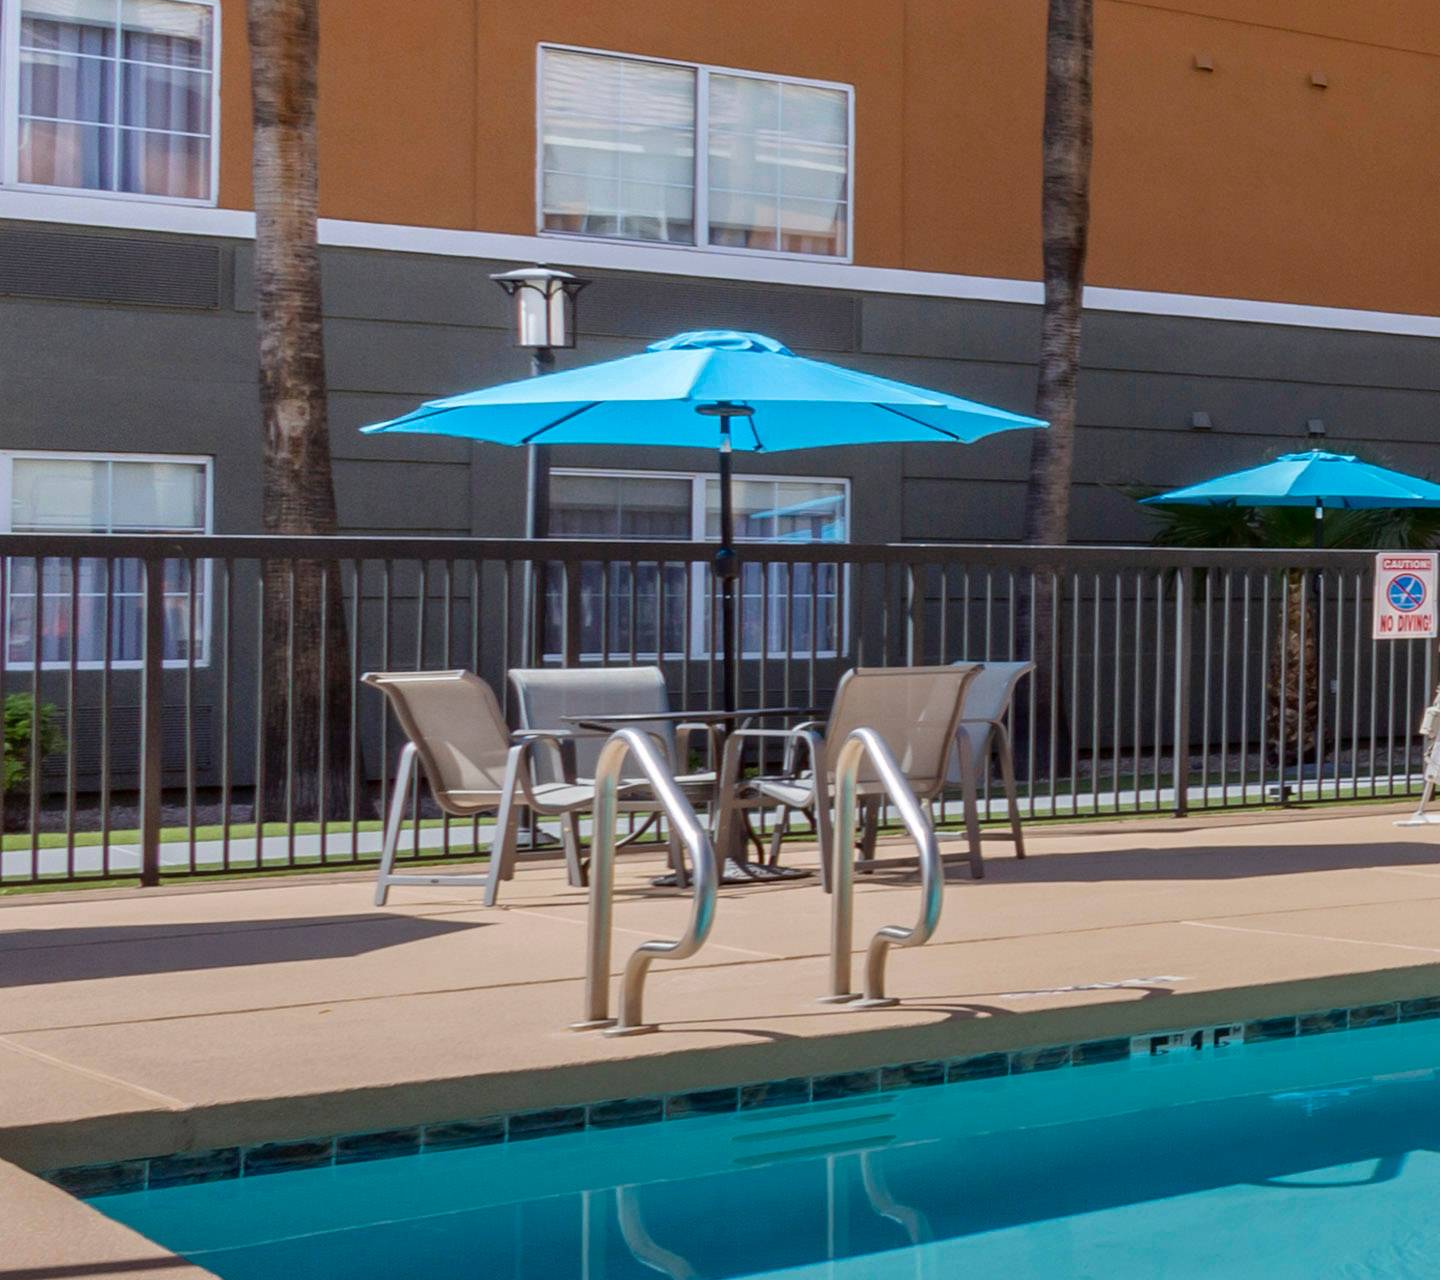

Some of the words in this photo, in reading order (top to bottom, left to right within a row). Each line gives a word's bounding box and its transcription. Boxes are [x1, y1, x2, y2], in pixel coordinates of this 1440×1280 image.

[1383, 559, 1431, 570] CAUTION!
[1380, 615, 1393, 632] NO
[1397, 614, 1432, 632] DIVING!
